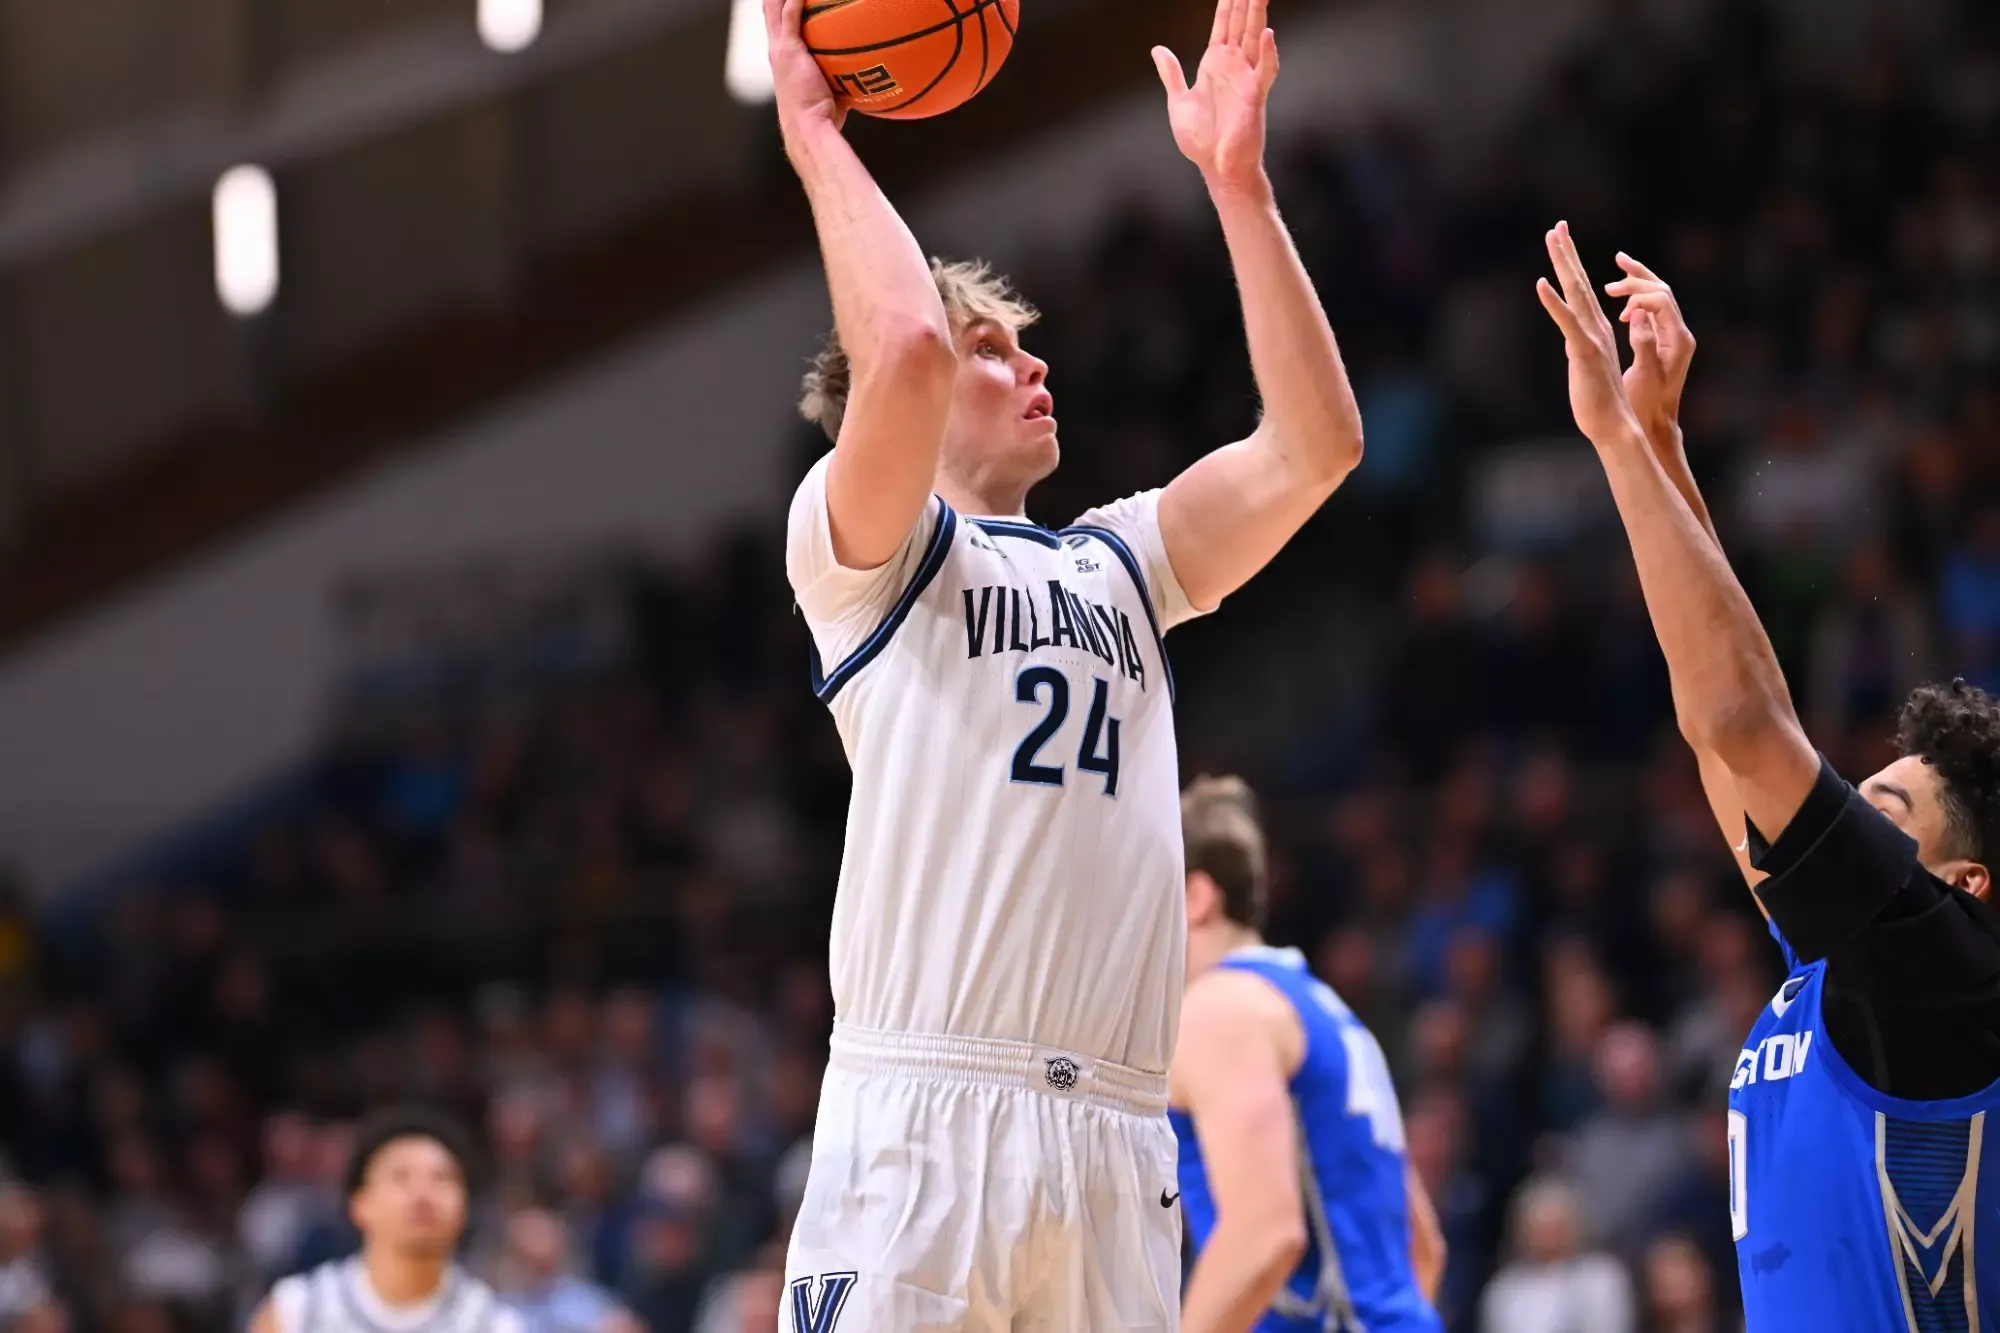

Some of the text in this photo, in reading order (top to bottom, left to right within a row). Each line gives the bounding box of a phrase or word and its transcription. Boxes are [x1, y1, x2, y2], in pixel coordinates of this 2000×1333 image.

[962, 579, 1146, 693] VILLANOVA
[1009, 664, 1121, 801] 24
[791, 1271, 858, 1333] V
